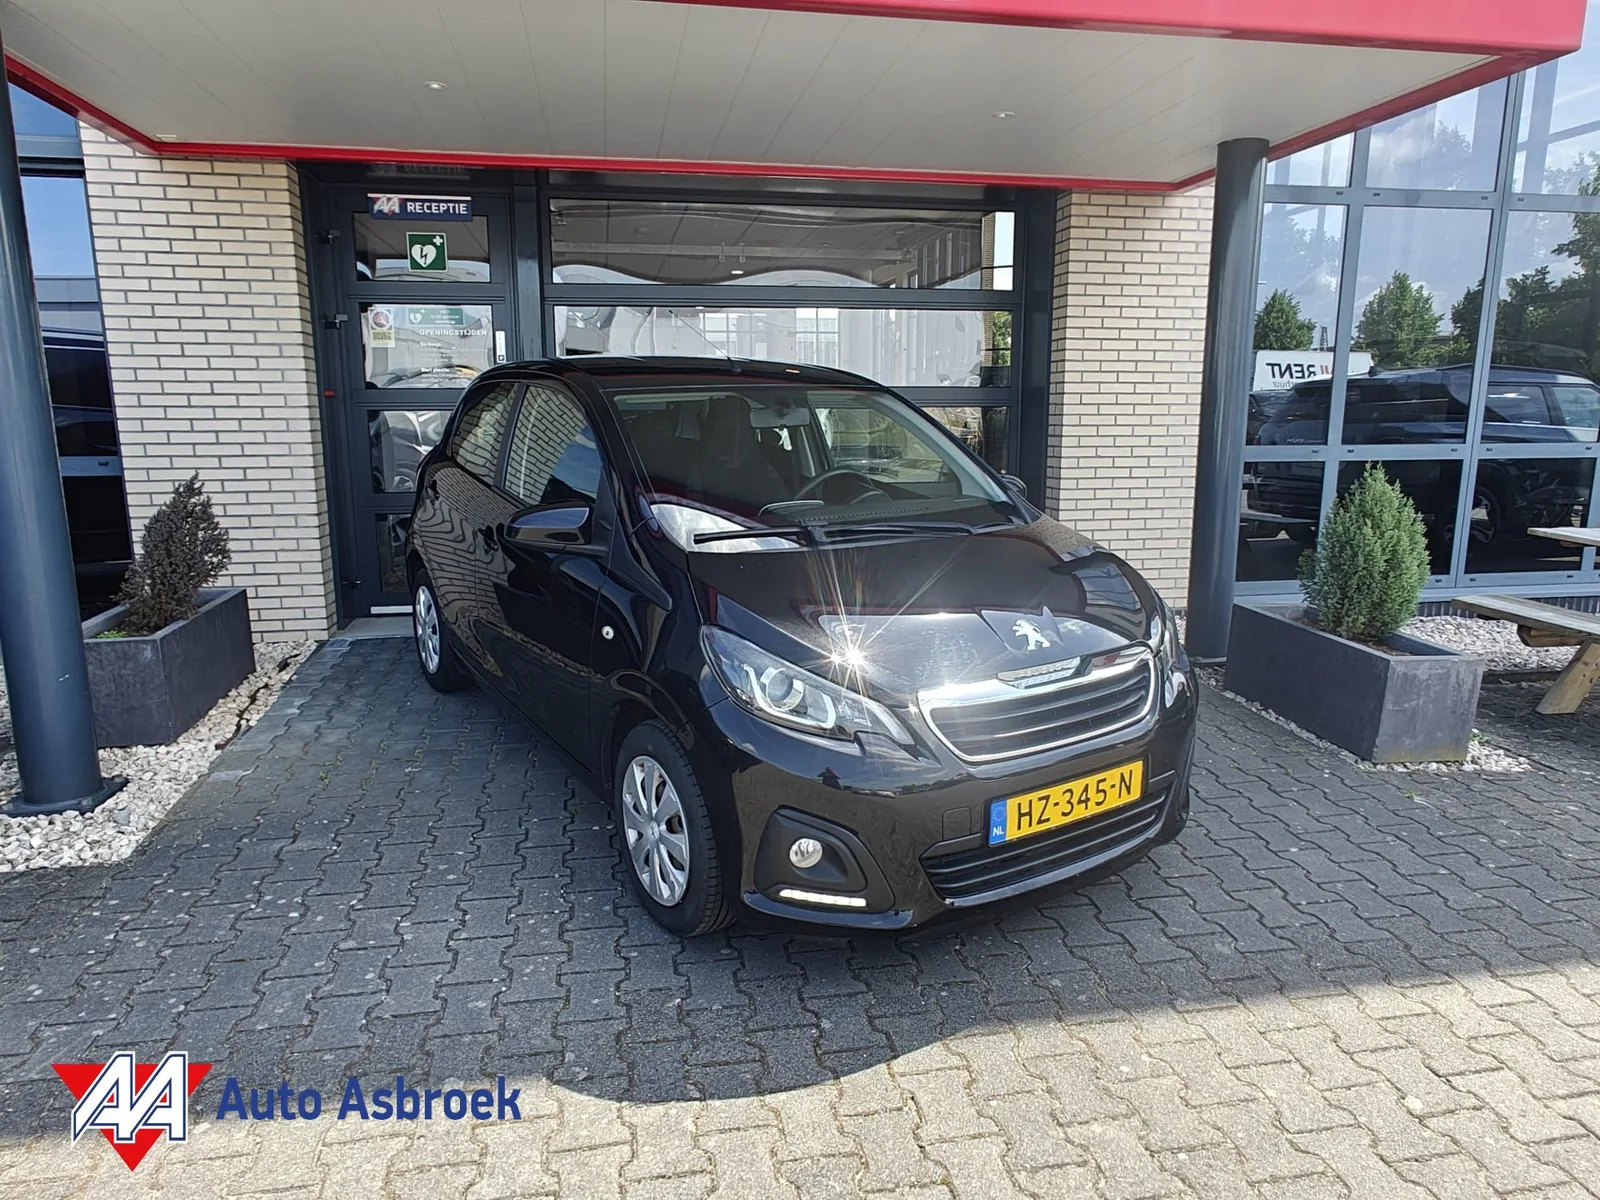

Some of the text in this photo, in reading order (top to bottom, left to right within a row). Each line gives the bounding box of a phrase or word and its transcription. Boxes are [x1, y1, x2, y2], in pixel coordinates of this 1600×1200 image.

[406, 201, 468, 214] RECEPTIE
[419, 328, 488, 337] OPENINGSTIJDEN
[1016, 768, 1134, 832] HZ-345-N
[992, 826, 1004, 836] NL
